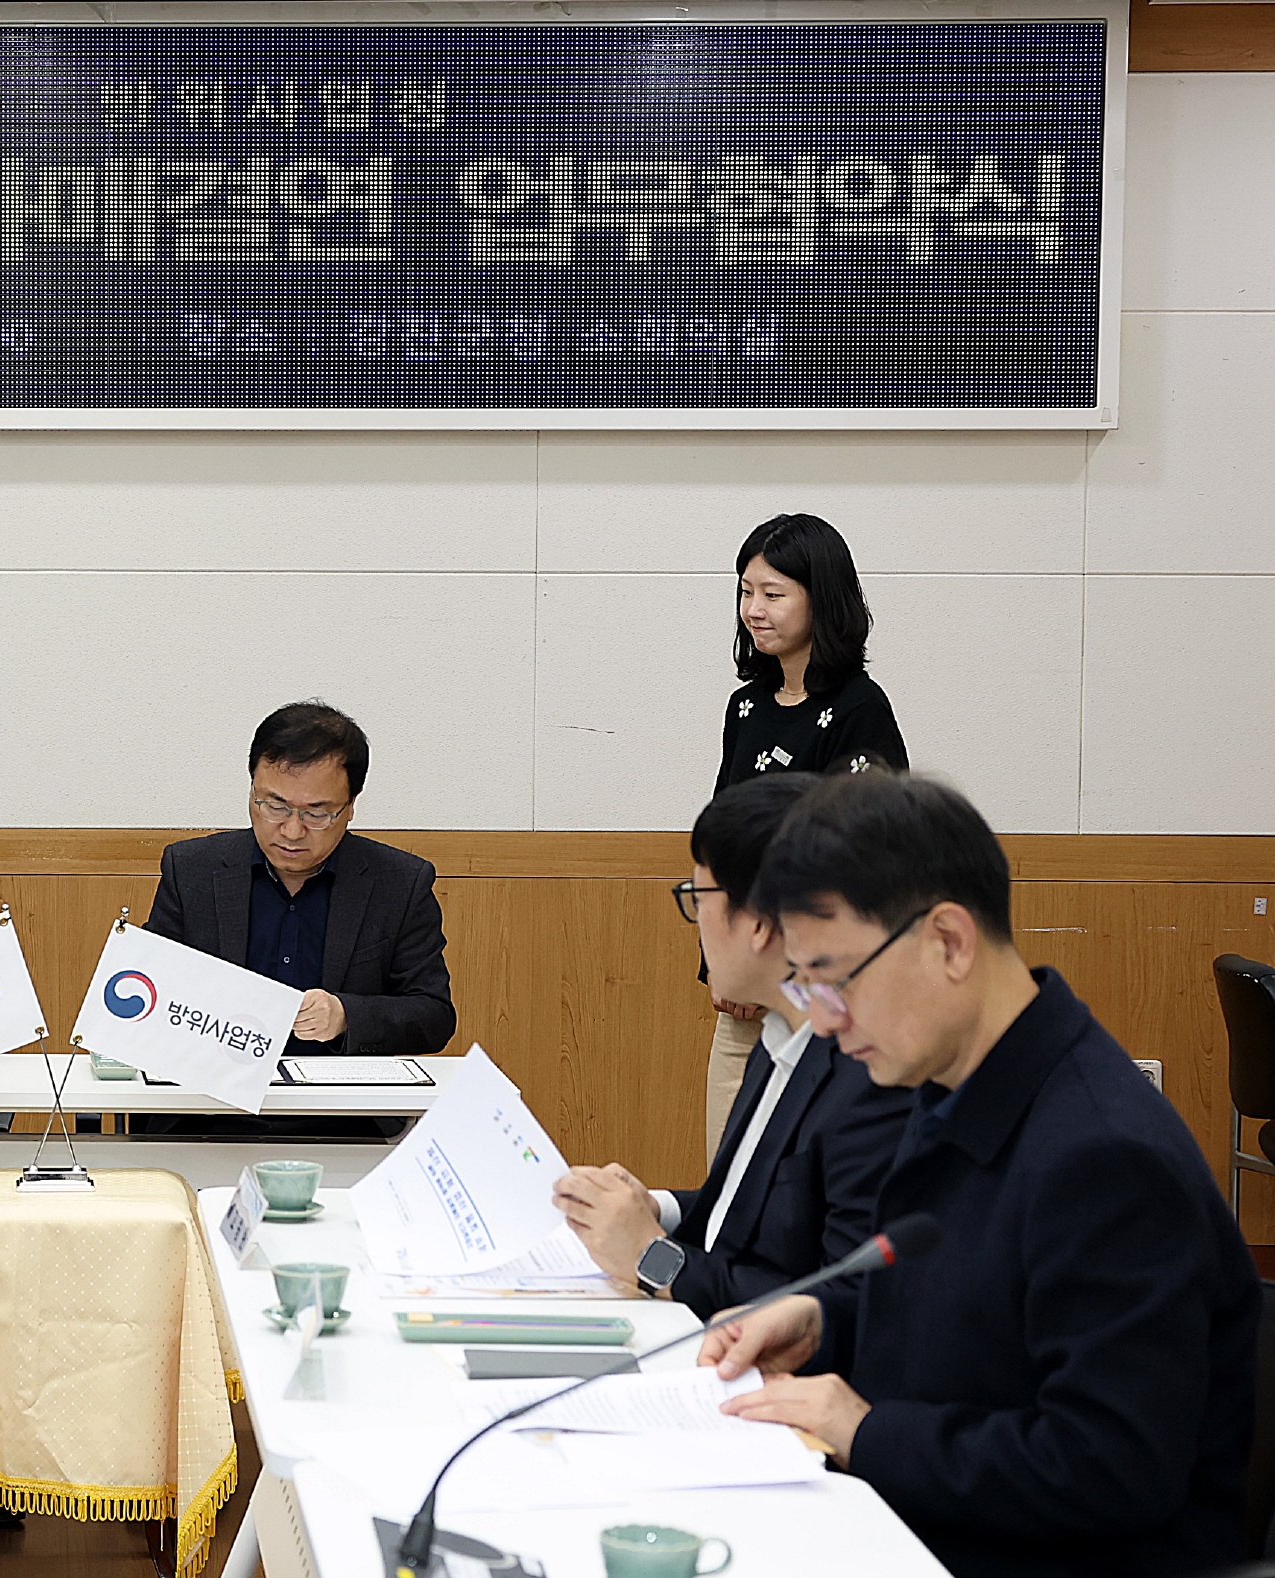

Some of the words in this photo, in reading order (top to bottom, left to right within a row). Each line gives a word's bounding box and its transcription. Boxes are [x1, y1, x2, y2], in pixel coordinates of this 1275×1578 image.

[101, 76, 446, 128] 방위사업청
[458, 154, 1065, 263] 업무협약식
[179, 312, 278, 360] 장소
[348, 311, 550, 362] 강진군청
[579, 311, 782, 361] 소회의실
[167, 1000, 273, 1058] 방위사업청
